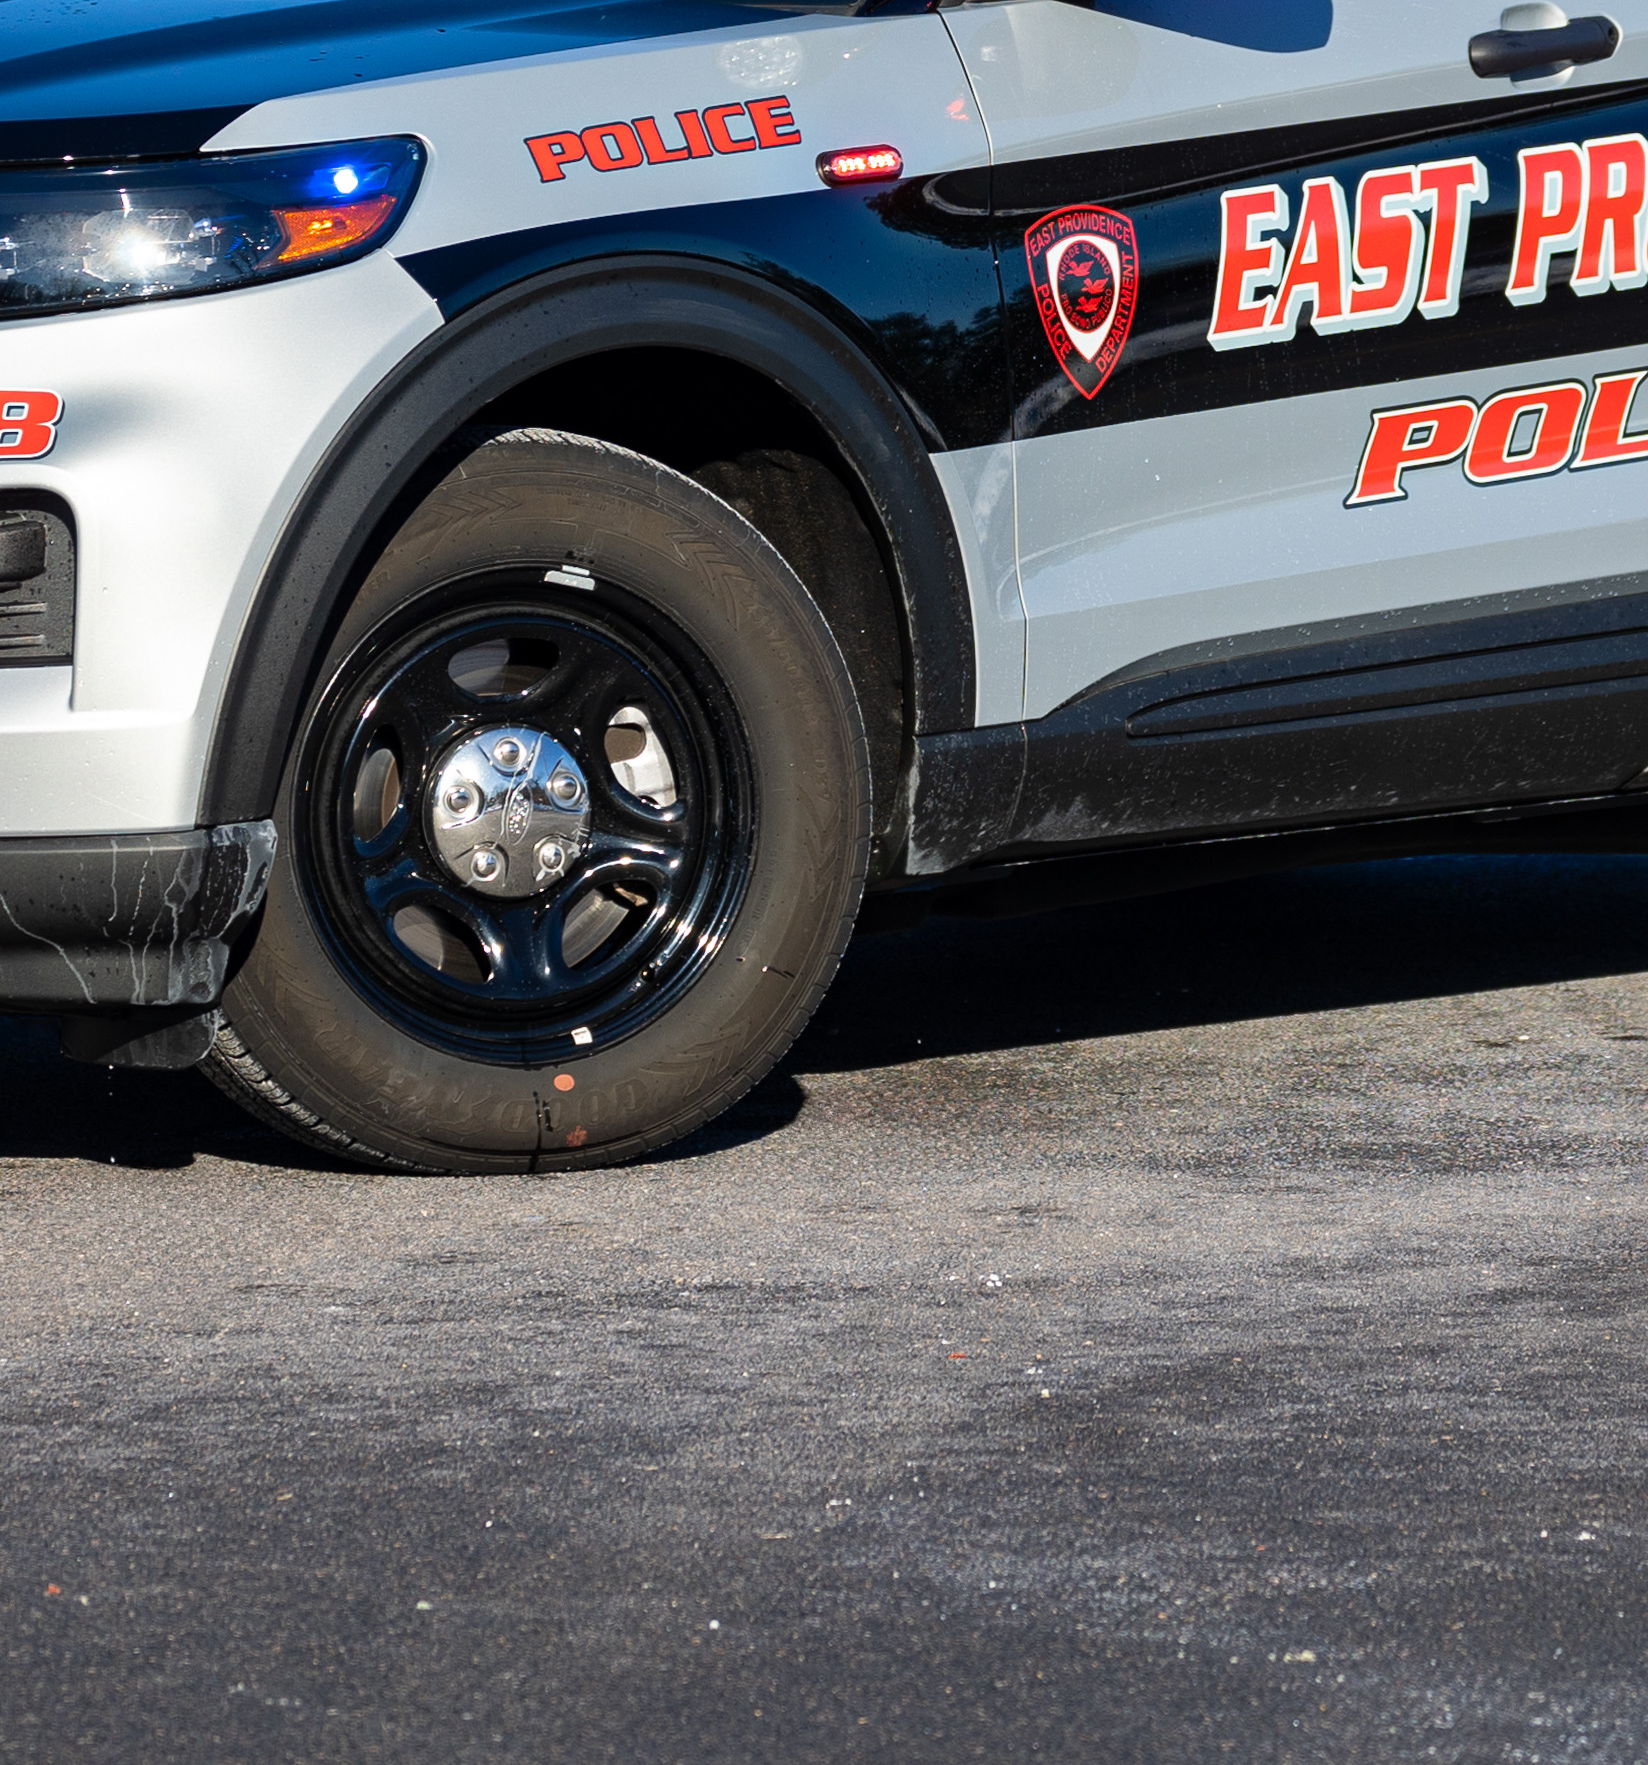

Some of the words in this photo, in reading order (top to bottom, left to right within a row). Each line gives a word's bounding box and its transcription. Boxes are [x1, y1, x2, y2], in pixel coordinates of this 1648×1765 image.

[523, 94, 803, 185] POLICE
[1029, 221, 1055, 258] EAST
[1058, 212, 1131, 246] PROVIDENCE
[1208, 156, 1490, 351] EAST
[1037, 283, 1072, 360] POLICE
[1095, 250, 1134, 373] DEPARTMENT
